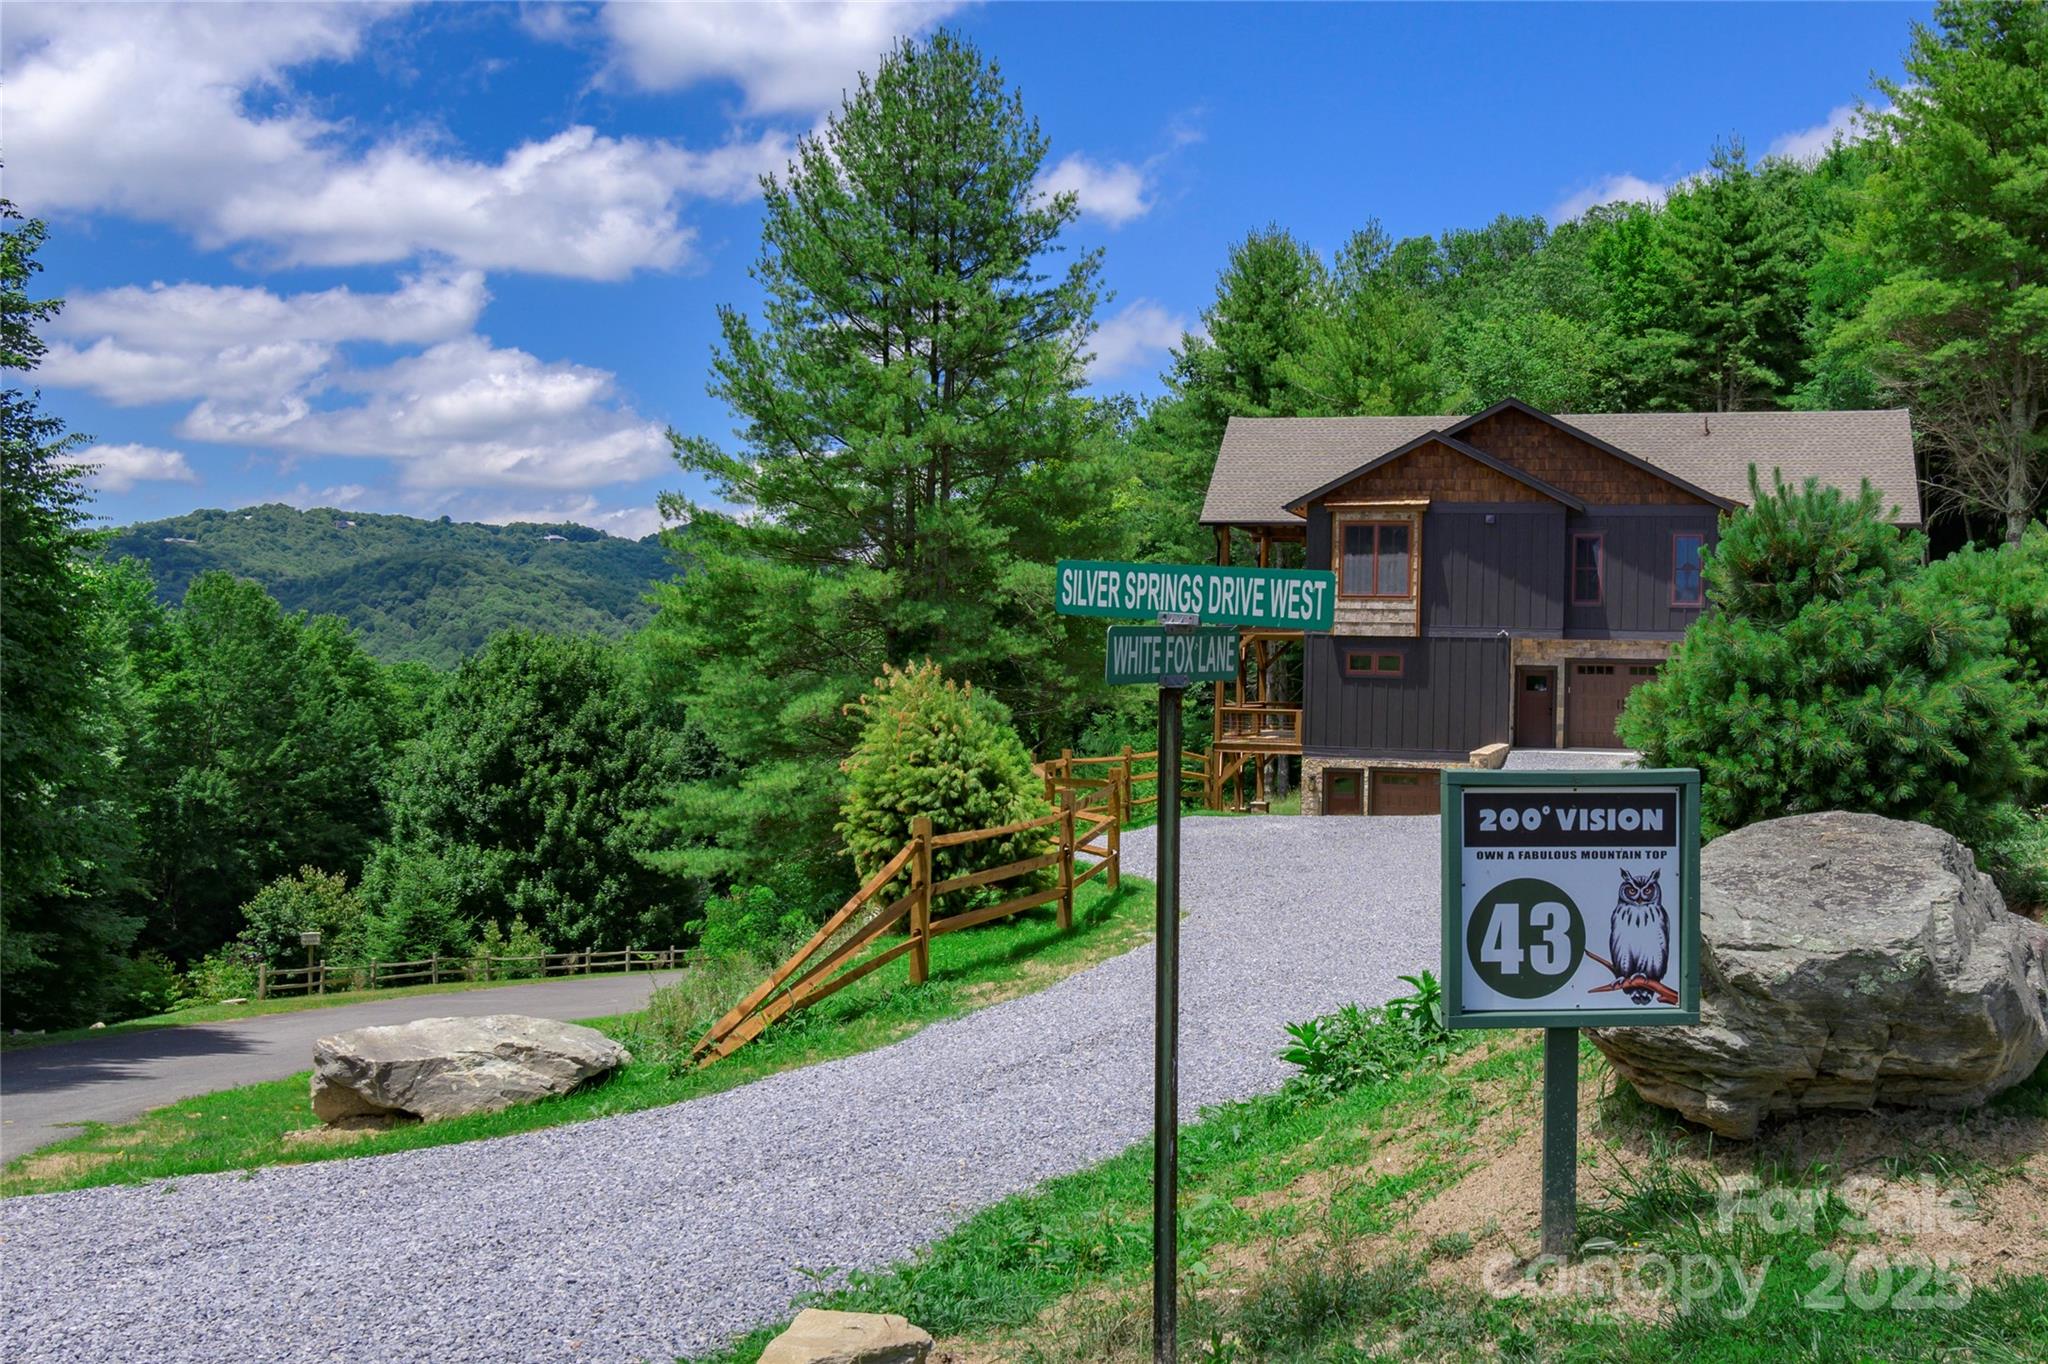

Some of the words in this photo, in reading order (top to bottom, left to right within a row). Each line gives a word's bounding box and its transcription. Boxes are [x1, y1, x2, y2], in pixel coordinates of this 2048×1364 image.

[1062, 568, 1120, 608] SILVER
[1124, 571, 1203, 613] SPRINGS
[1208, 575, 1265, 617] DRIVE
[1270, 578, 1327, 620] WEST
[1113, 635, 1161, 675] WHITE
[1165, 635, 1195, 673] FOX
[1198, 635, 1236, 673] LANE
[1479, 805, 1551, 831] 200°
[1555, 808, 1664, 831] VISION
[1476, 850, 1504, 860] OWN
[1507, 850, 1515, 860] A
[1518, 850, 1577, 860] FABULOUS
[1580, 849, 1641, 860] MOUNTAIN
[1645, 850, 1668, 860] TOP
[1480, 901, 1572, 975] 43
